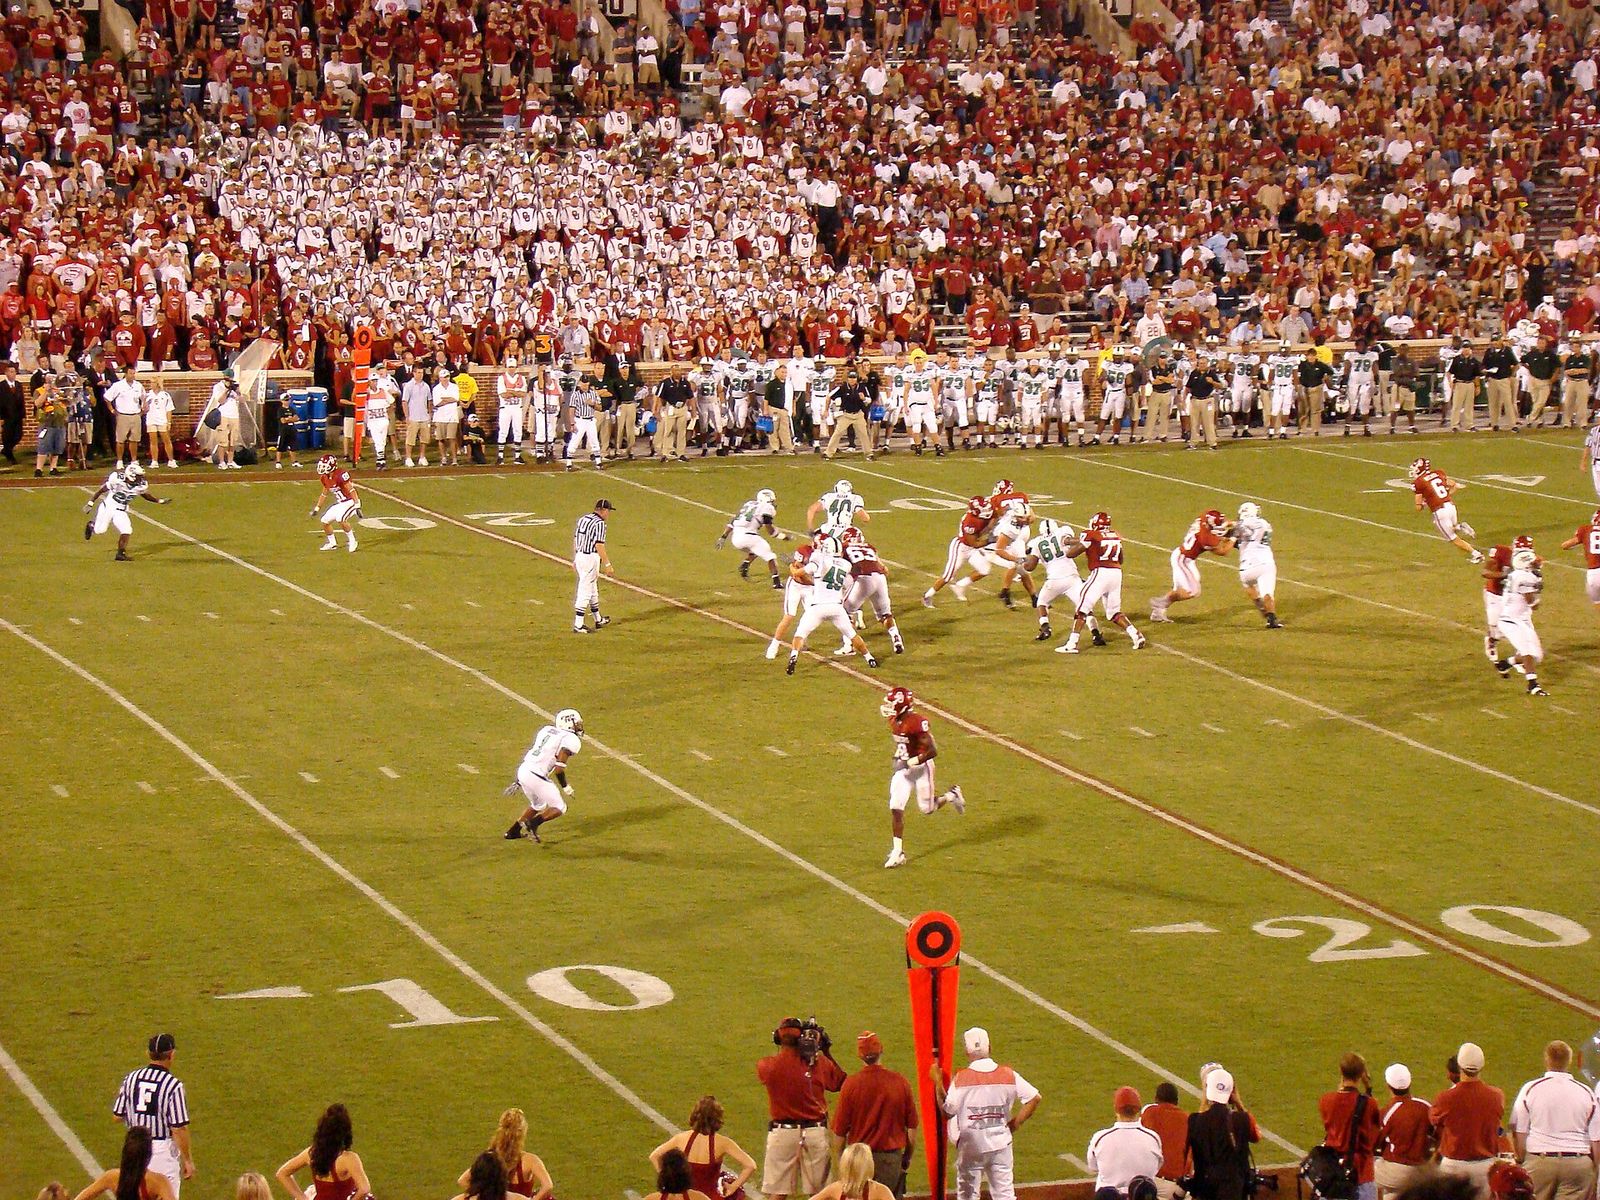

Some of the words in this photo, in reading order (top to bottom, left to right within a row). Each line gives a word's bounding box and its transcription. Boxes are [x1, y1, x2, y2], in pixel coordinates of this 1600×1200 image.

[535, 335, 551, 353] 3
[1064, 368, 1080, 382] 41
[1431, 478, 1448, 499] 6
[1038, 535, 1065, 563] 61
[1100, 539, 1122, 562] 77
[823, 565, 847, 591] 45
[1252, 905, 1591, 962] 20
[336, 965, 675, 1030] 10
[136, 1081, 158, 1112] F
